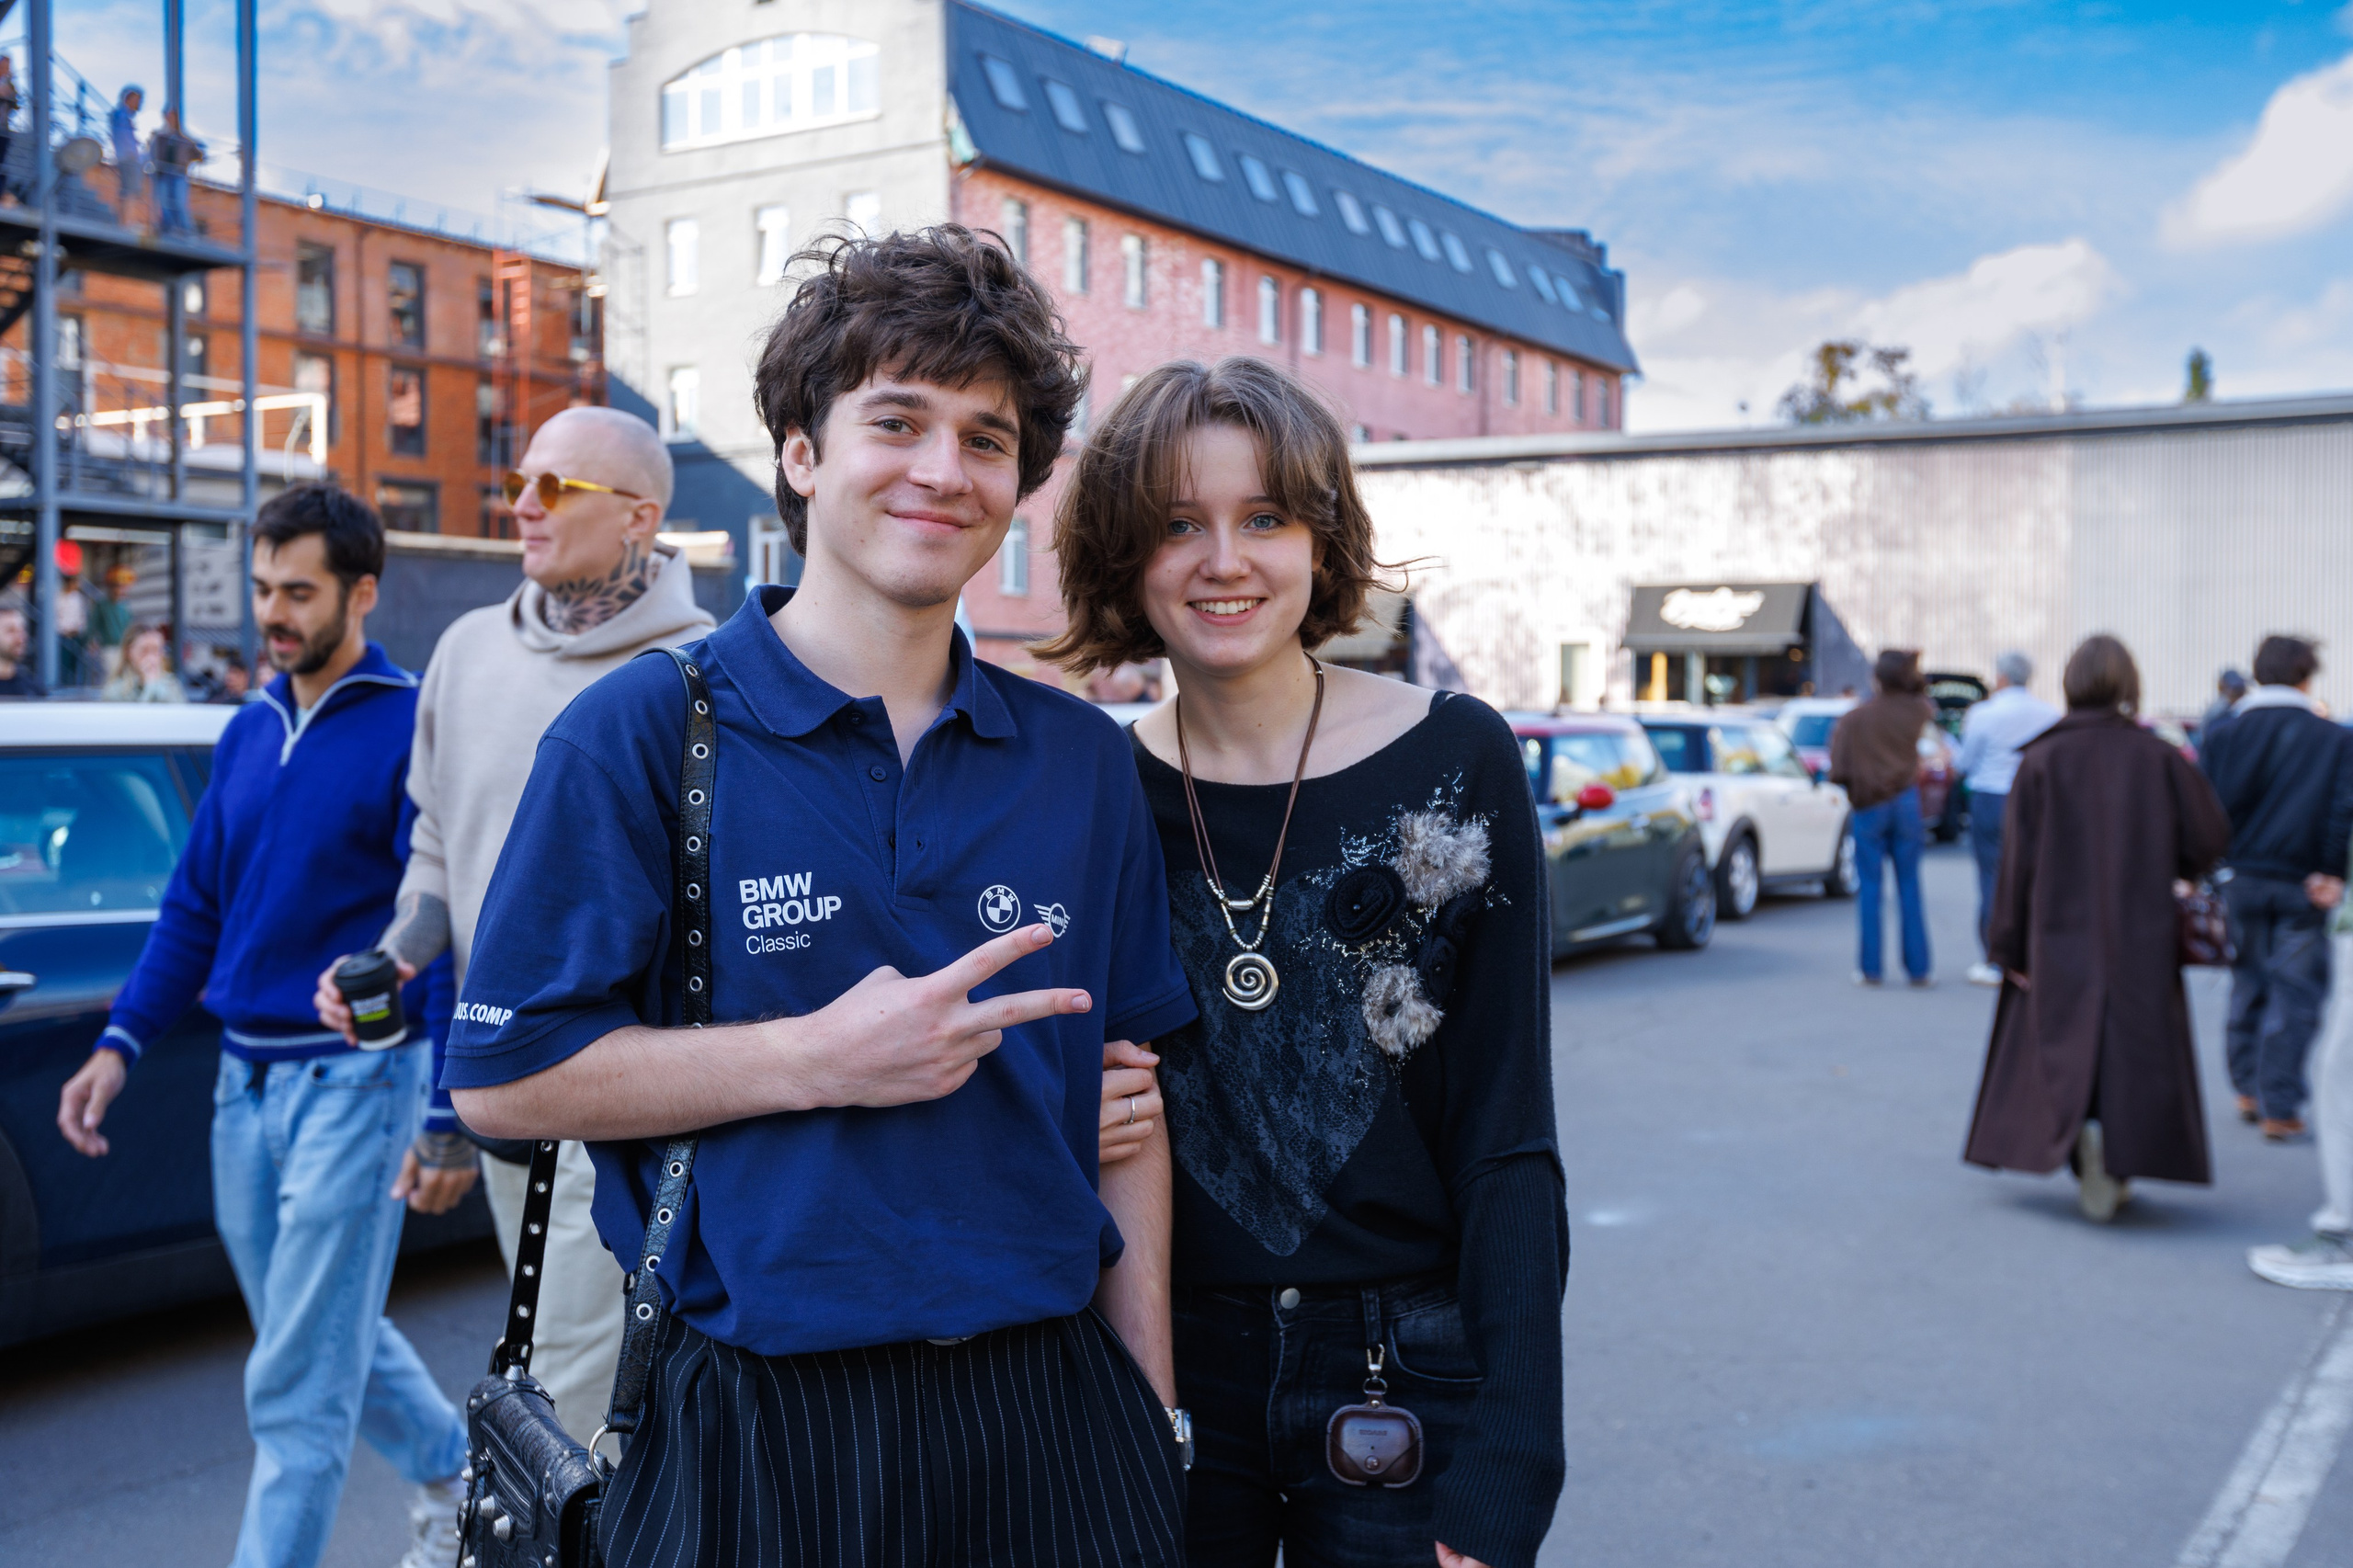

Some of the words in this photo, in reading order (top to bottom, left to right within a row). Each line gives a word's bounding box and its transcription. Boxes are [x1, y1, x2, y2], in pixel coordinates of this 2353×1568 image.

[739, 871, 812, 903] BMW
[985, 887, 1017, 903] BMW
[743, 895, 842, 929] GROUP
[1051, 914, 1064, 926] MINI
[745, 930, 811, 955] Classic
